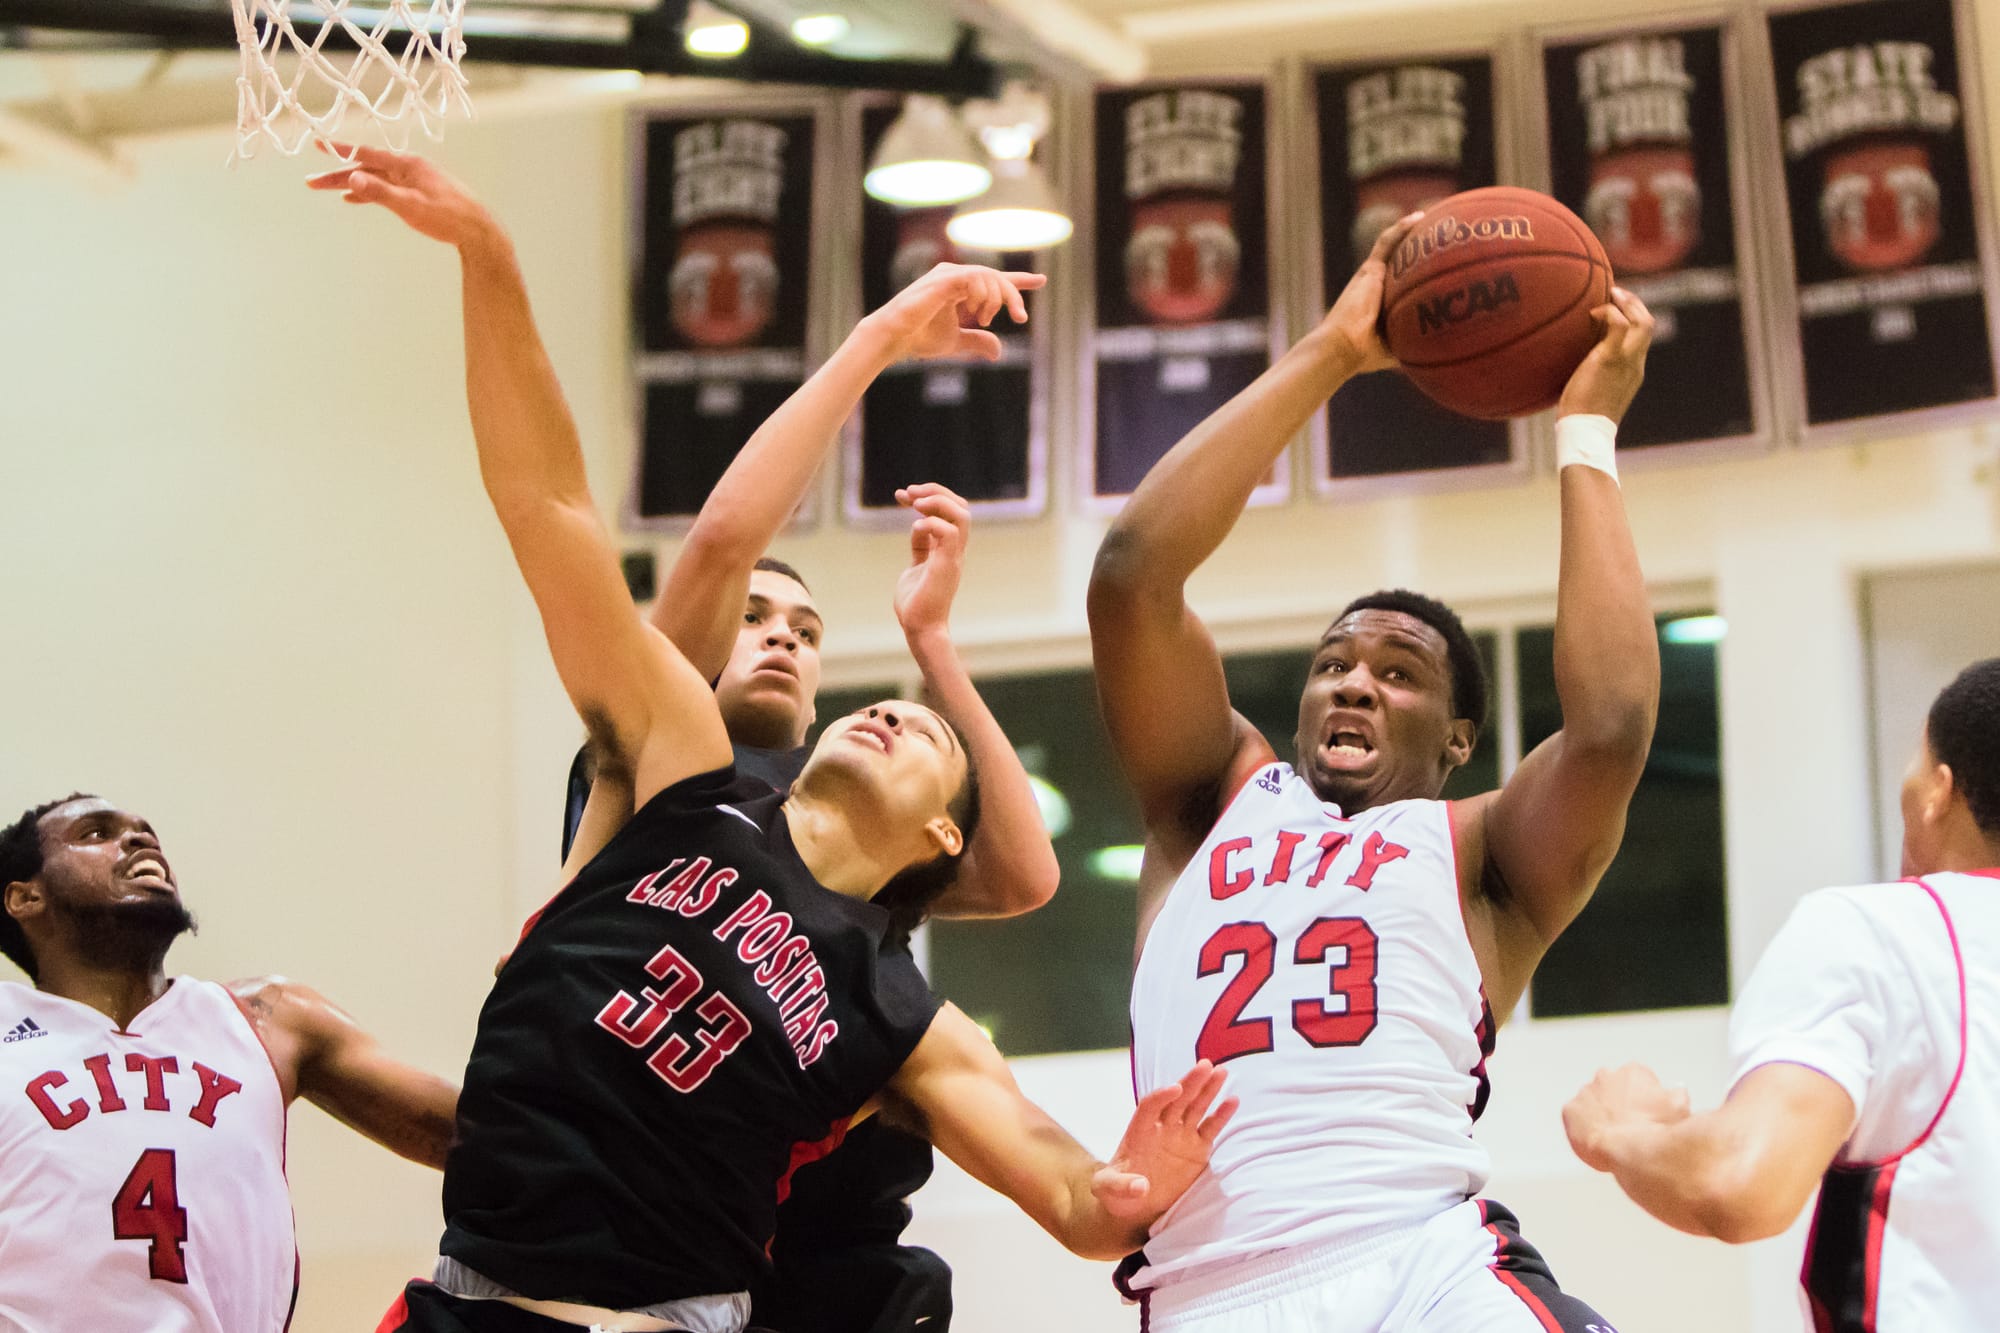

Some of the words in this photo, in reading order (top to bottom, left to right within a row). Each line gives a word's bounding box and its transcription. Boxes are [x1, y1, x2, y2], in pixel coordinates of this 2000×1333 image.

[1389, 216, 1535, 281] Wilson
[1416, 272, 1520, 335] NCAA
[1208, 829, 1411, 901] CITY
[626, 856, 740, 918] LAS
[713, 889, 838, 1070] POSITAS
[1195, 916, 1379, 1066] 23
[3, 1030, 49, 1043] adidas
[594, 943, 752, 1093] 33
[25, 1053, 242, 1130] CITY
[112, 1148, 188, 1285] 4
